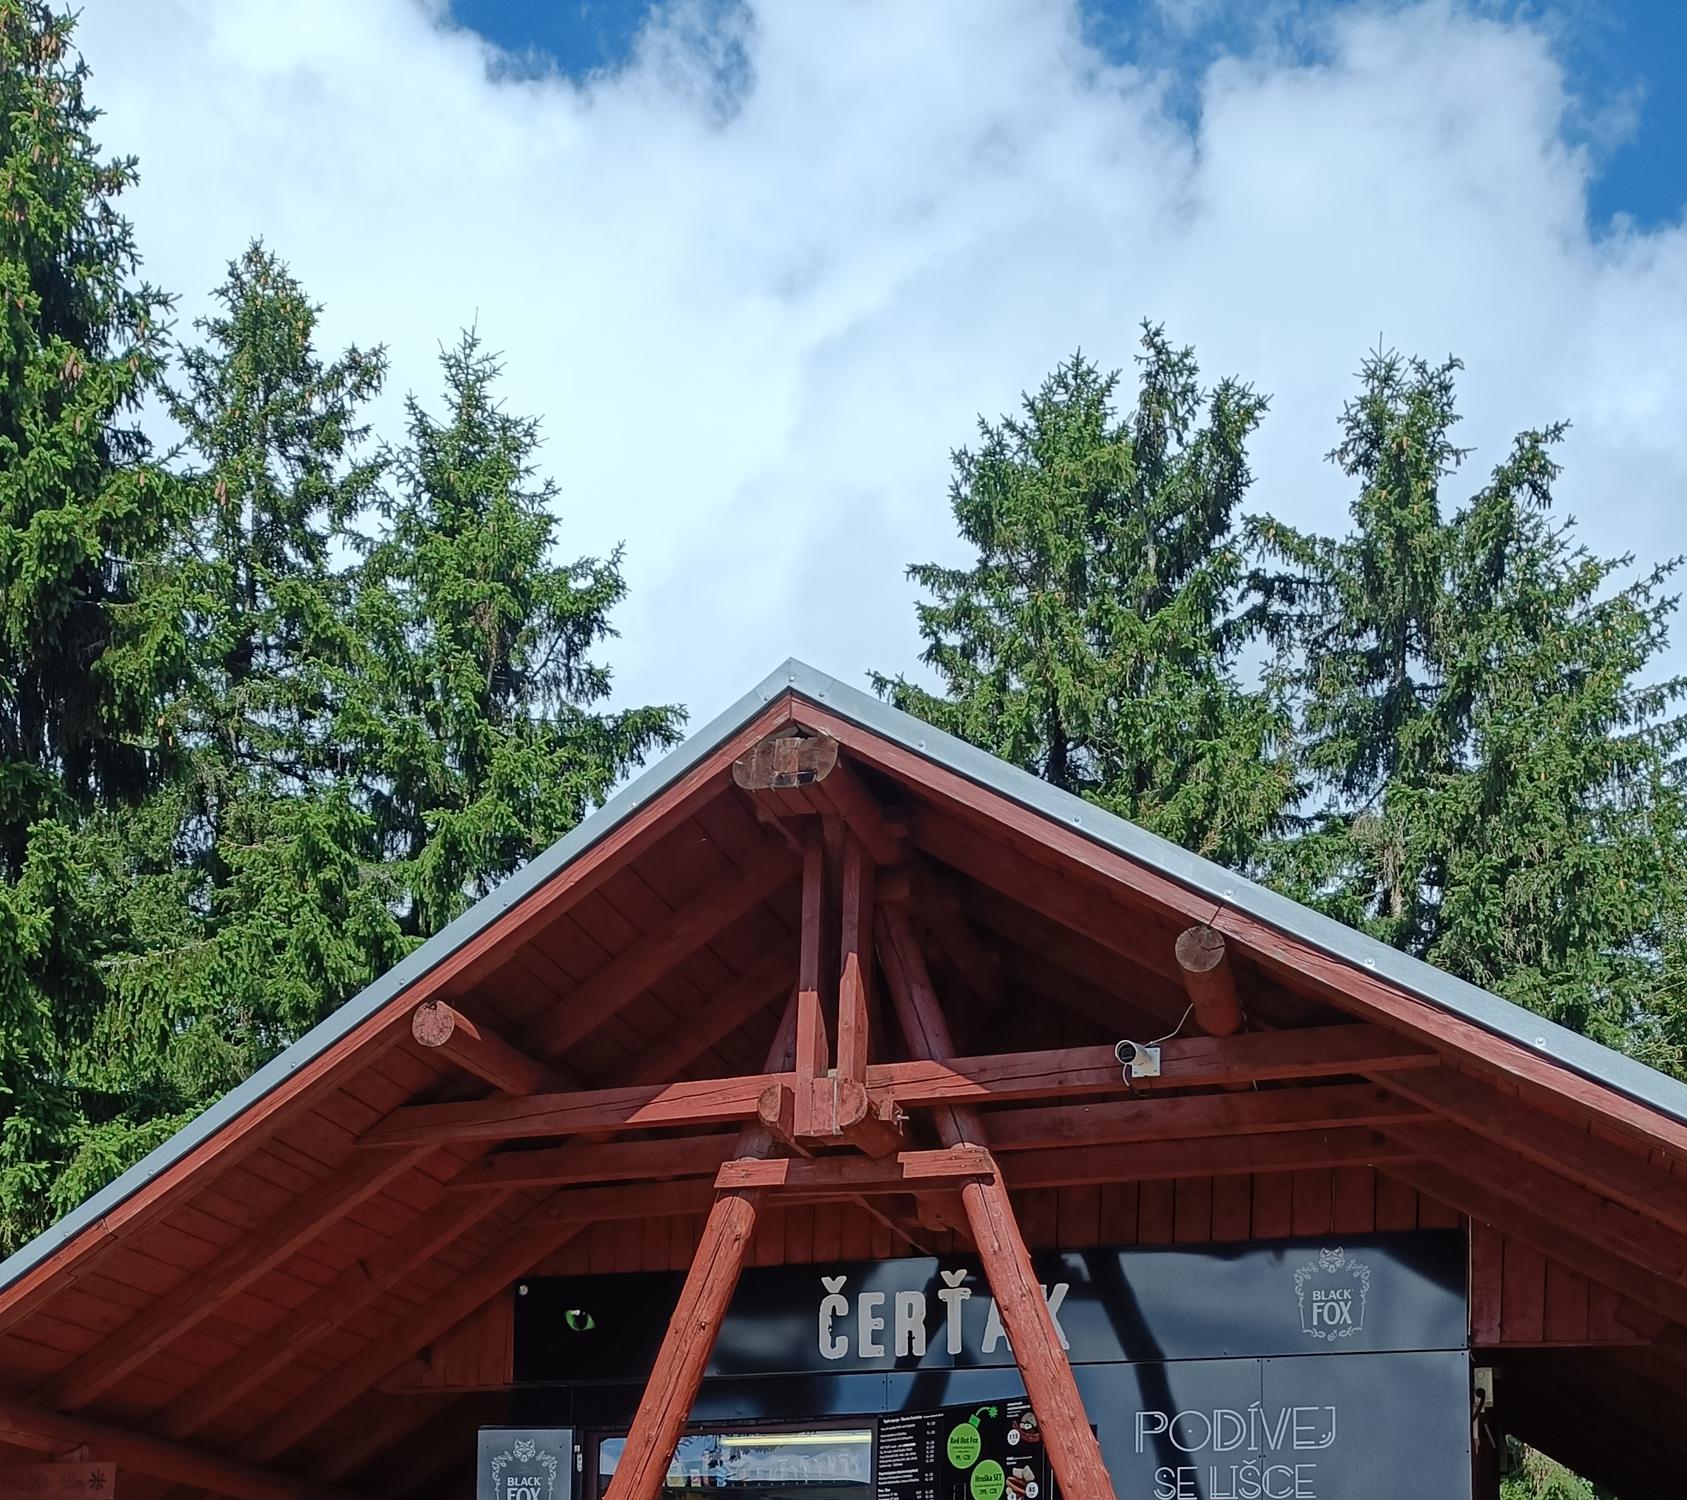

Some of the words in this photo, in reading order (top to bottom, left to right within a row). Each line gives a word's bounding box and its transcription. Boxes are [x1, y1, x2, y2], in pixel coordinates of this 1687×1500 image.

[1313, 1289, 1352, 1301] BLACK
[1312, 1301, 1352, 1326] FOX
[1135, 1401, 1336, 1453] PODÍVEJ
[507, 1476, 541, 1486] BLACK
[1153, 1466, 1198, 1500] SE
[1210, 1459, 1317, 1500] LIŠCE
